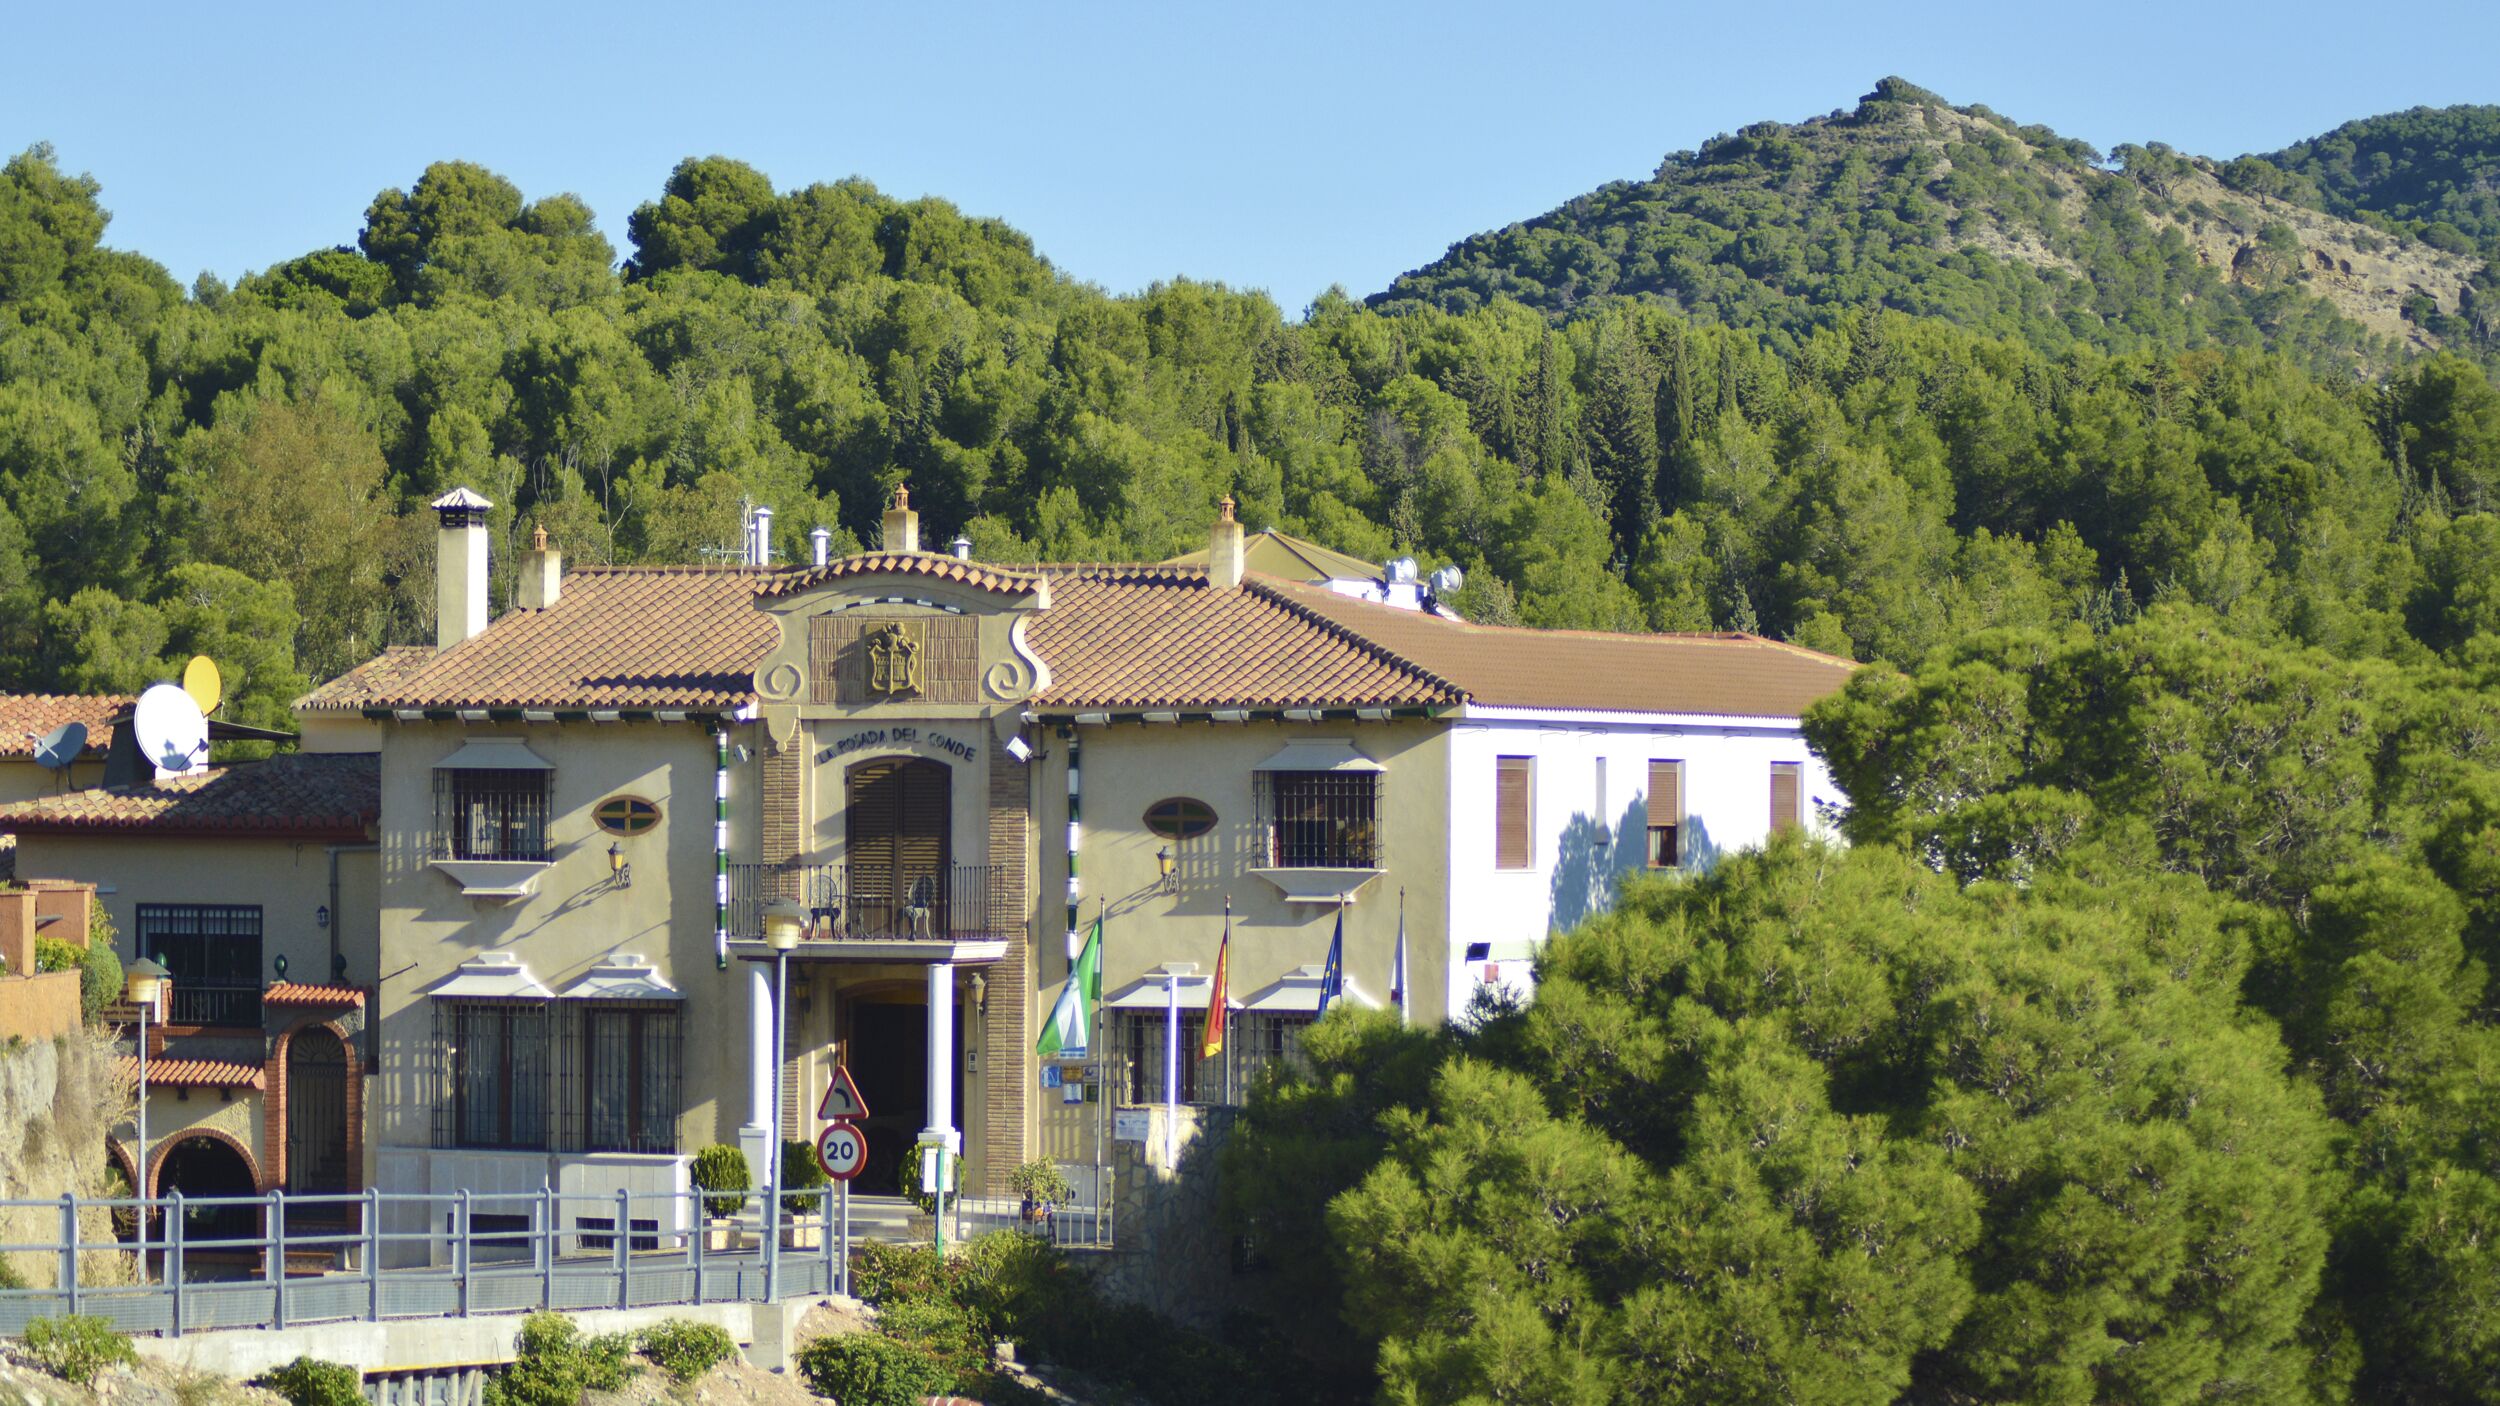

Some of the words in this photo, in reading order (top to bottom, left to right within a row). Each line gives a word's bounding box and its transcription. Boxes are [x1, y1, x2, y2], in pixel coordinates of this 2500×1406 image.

[818, 749, 836, 763] LA
[837, 730, 887, 753] POSADA
[892, 728, 921, 743] DEL
[928, 733, 976, 762] CONDE
[826, 1141, 854, 1160] 20
